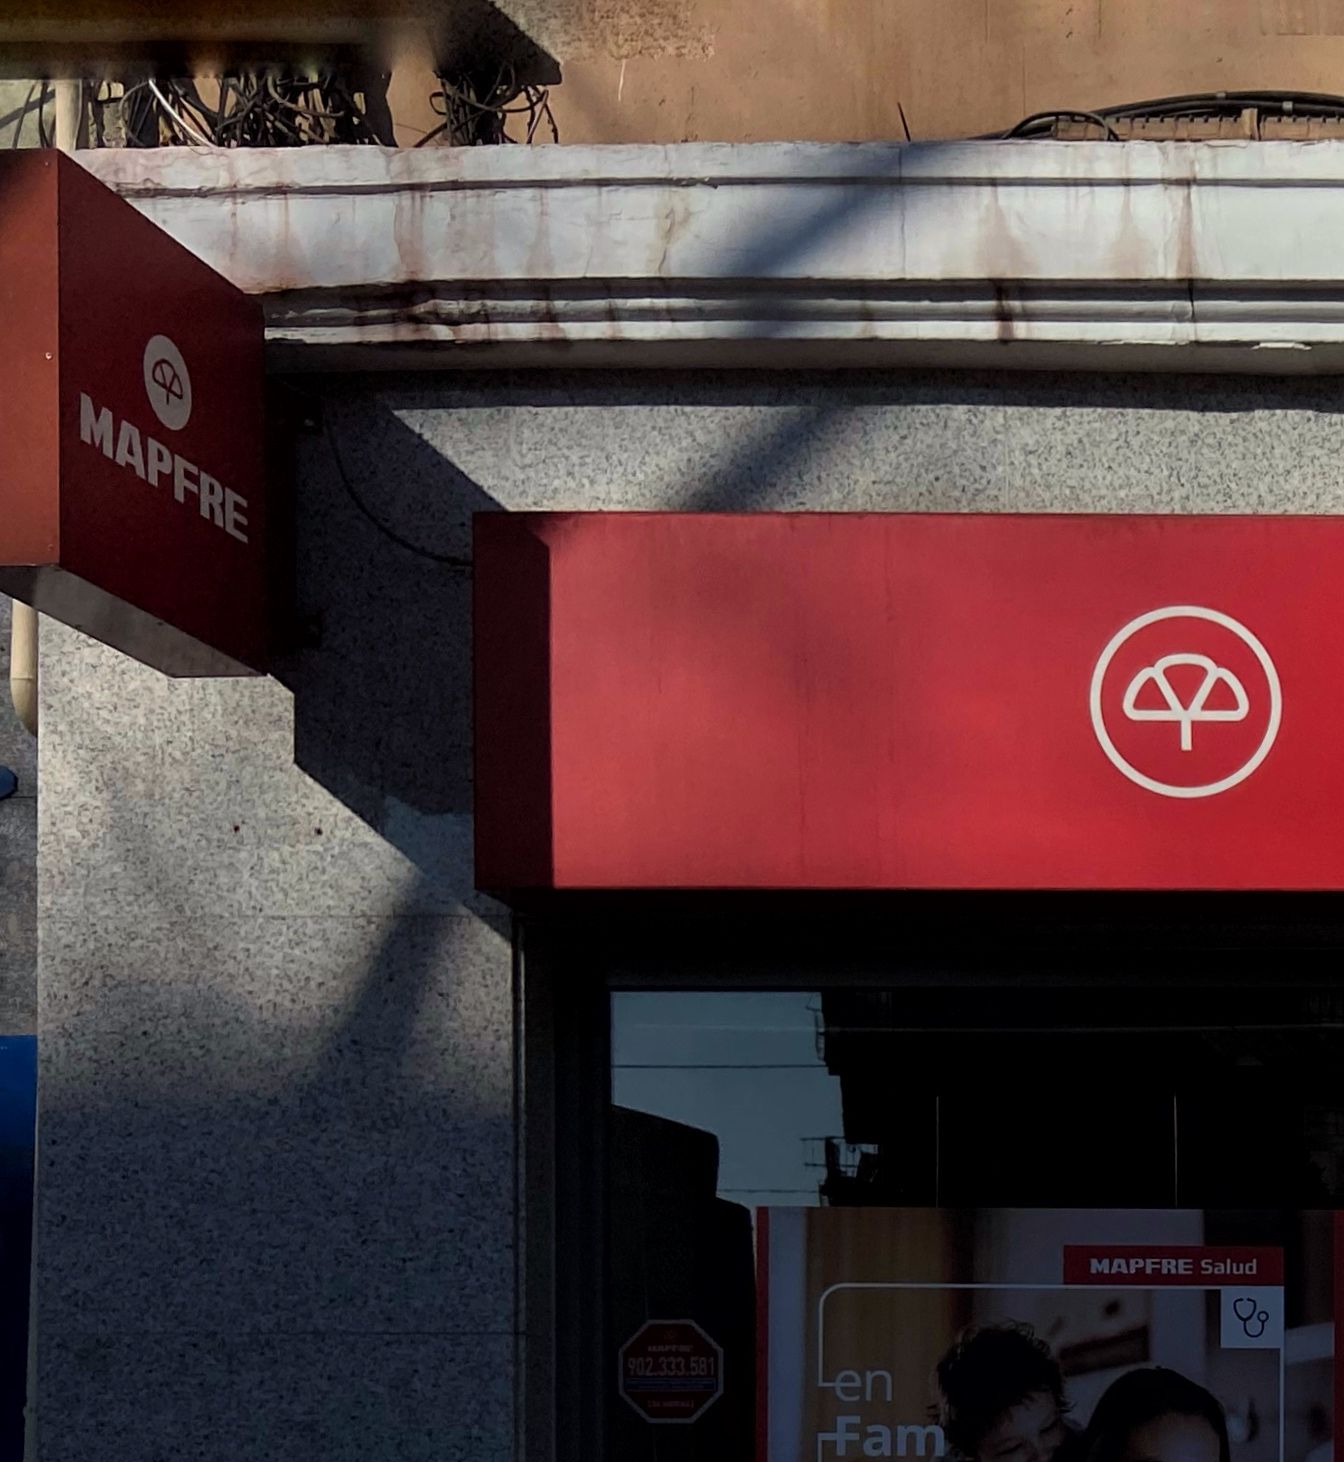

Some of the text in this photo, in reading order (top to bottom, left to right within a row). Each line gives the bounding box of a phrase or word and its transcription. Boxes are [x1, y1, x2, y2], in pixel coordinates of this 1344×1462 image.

[79, 390, 249, 544] MAPFRE
[1090, 1258, 1257, 1275] MAPFRE Salud
[833, 1369, 893, 1401] en
[835, 1415, 945, 1456] Fam
